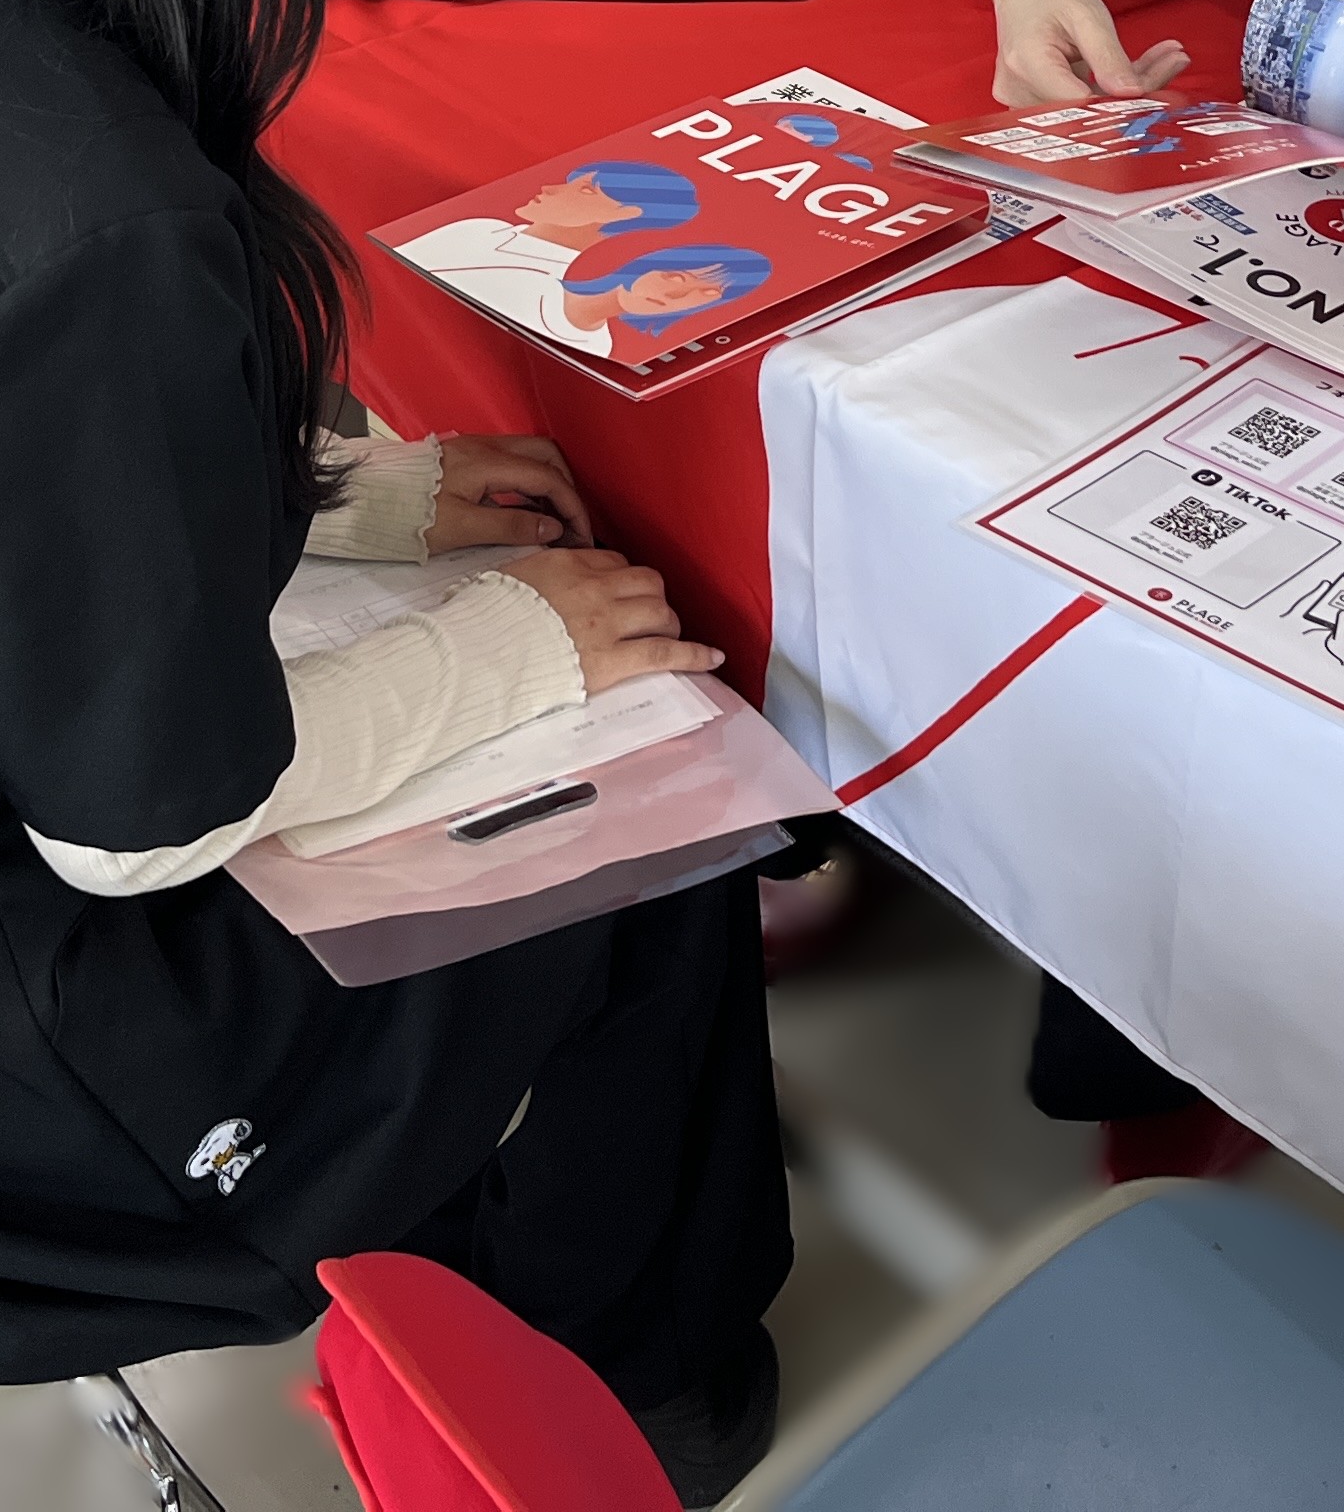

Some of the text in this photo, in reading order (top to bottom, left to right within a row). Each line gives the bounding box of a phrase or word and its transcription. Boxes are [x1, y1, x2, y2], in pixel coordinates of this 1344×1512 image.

[651, 109, 954, 238] PLAGE
[1224, 483, 1293, 521] TikTok
[1175, 598, 1234, 631] PLAGE
